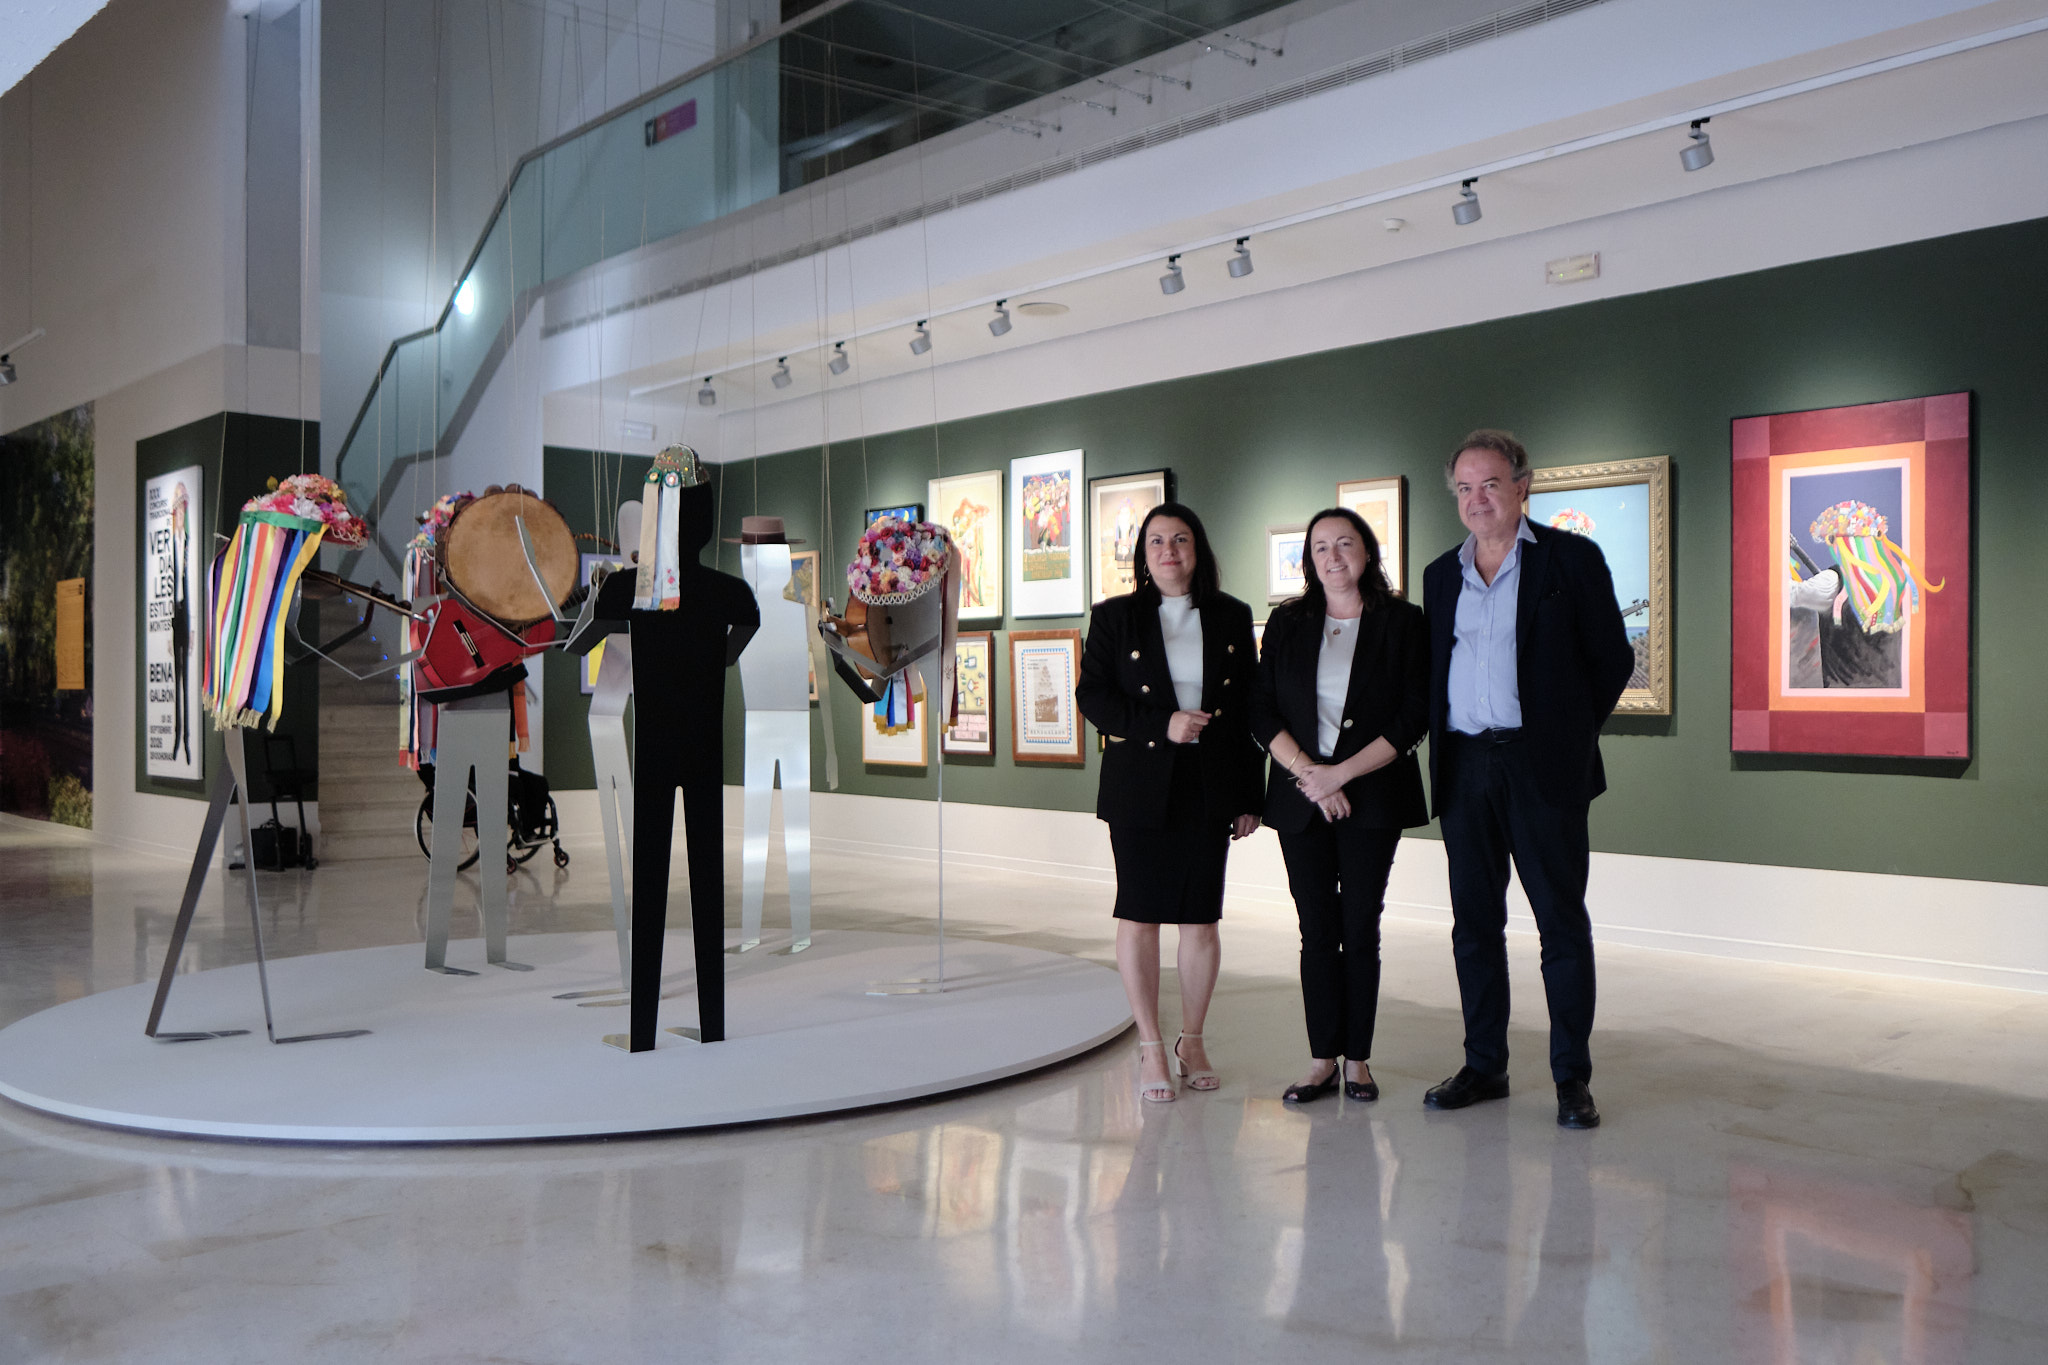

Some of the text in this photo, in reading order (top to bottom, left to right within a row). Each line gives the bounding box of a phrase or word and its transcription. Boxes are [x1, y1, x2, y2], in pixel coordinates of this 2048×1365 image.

[149, 529, 171, 555] VER
[160, 554, 174, 574] DIA
[154, 575, 174, 599] LES
[150, 600, 174, 618] ESTILO
[150, 618, 171, 632] MONTES
[150, 663, 174, 683] BENA
